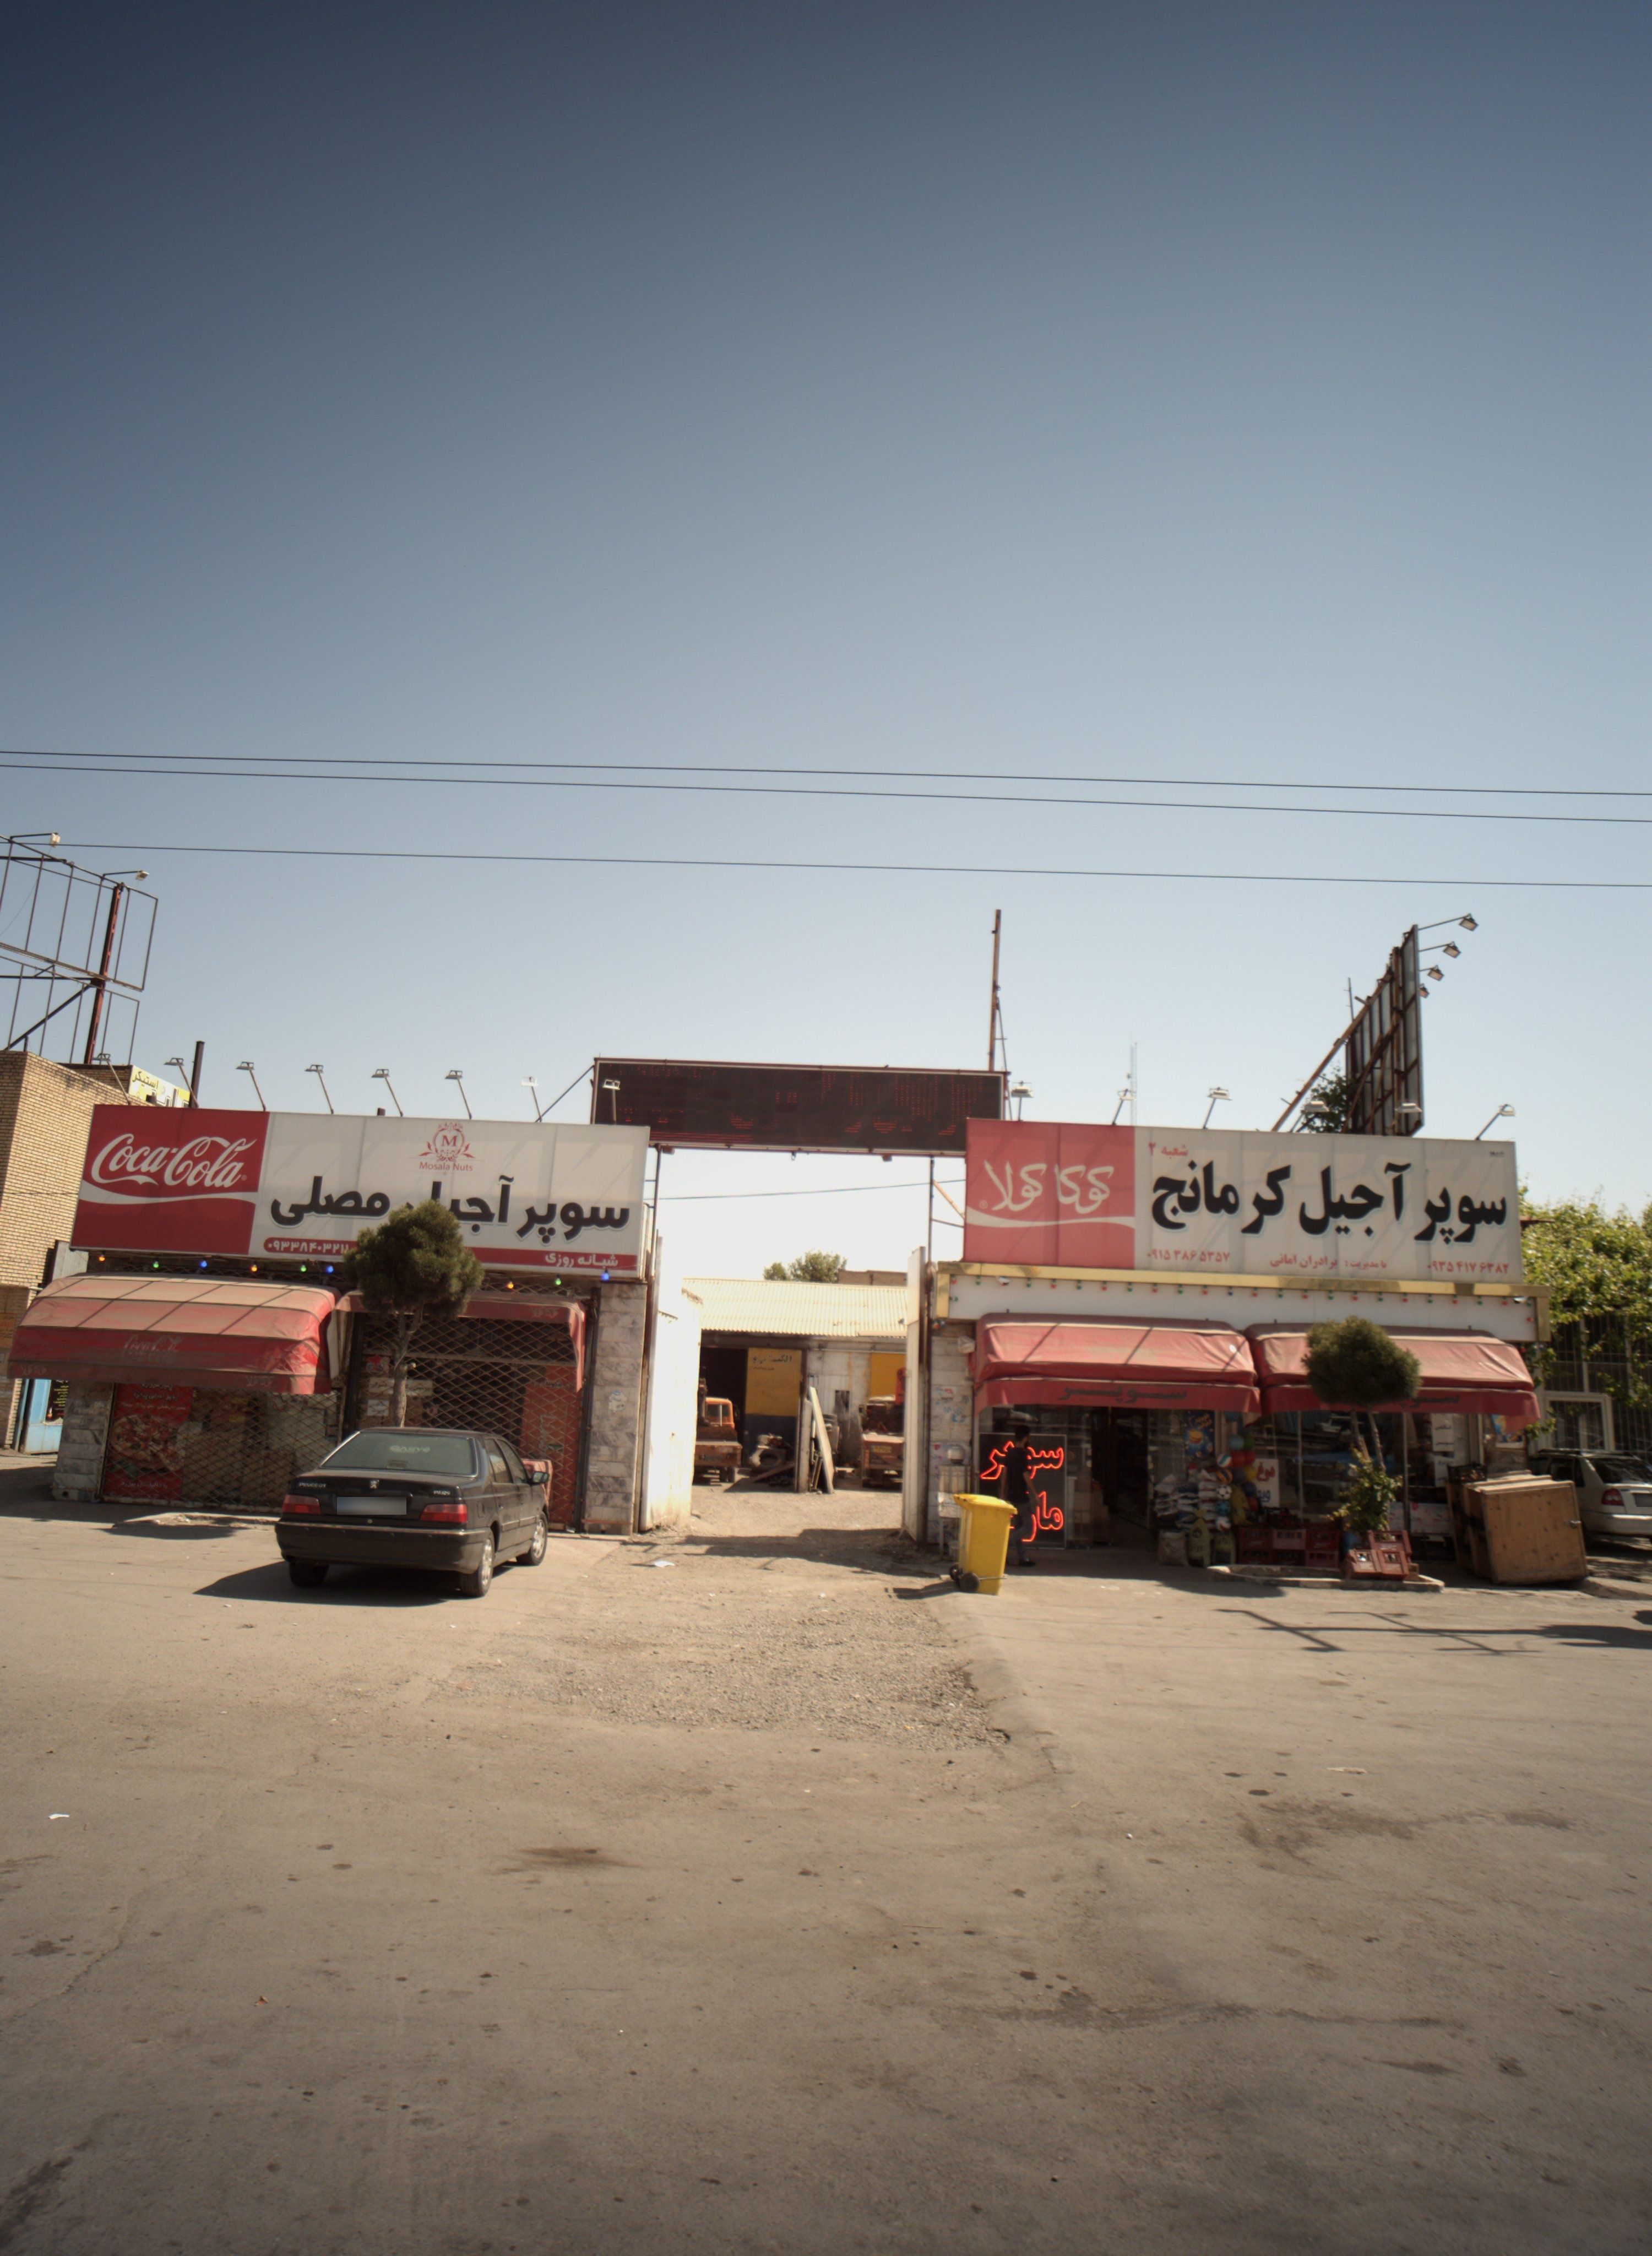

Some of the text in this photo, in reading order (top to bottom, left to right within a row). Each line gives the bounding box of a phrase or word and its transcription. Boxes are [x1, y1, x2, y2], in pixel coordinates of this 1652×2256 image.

[91, 1133, 257, 1188] Coca-Cola
[420, 1162, 450, 1170] Mosala
[1161, 1145, 1188, 1159] شعبه
[271, 1176, 390, 1227] مصلی
[985, 1160, 1115, 1214] کوکا کولا
[1152, 1160, 1507, 1244] سوپر آجیل کرمانج
[517, 1200, 630, 1245] سوپر
[545, 1252, 618, 1268] شبانه روزی
[1300, 1255, 1338, 1270] برادران
[1058, 1386, 1187, 1403] سوپر
